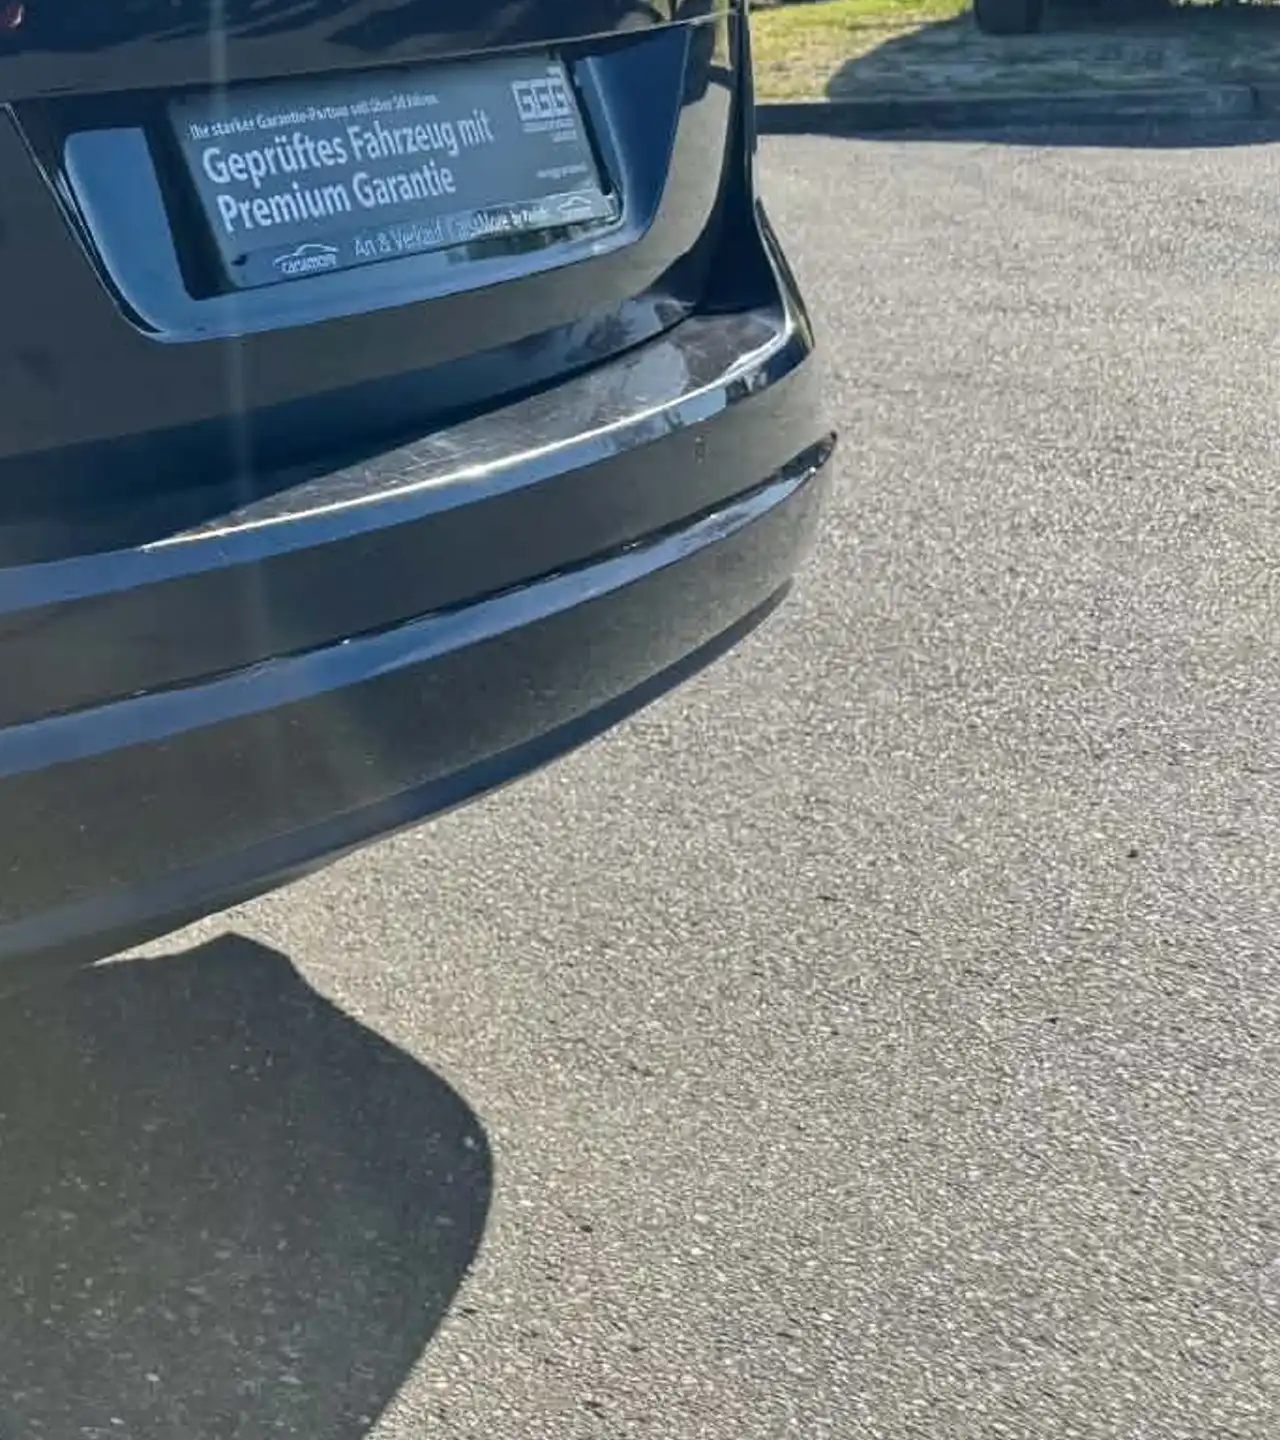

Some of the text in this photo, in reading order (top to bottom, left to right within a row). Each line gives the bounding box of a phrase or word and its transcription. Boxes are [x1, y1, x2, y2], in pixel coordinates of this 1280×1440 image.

[202, 108, 494, 190] Geprüftes Fahrzeug mit
[216, 157, 457, 233] Premium Garantie
